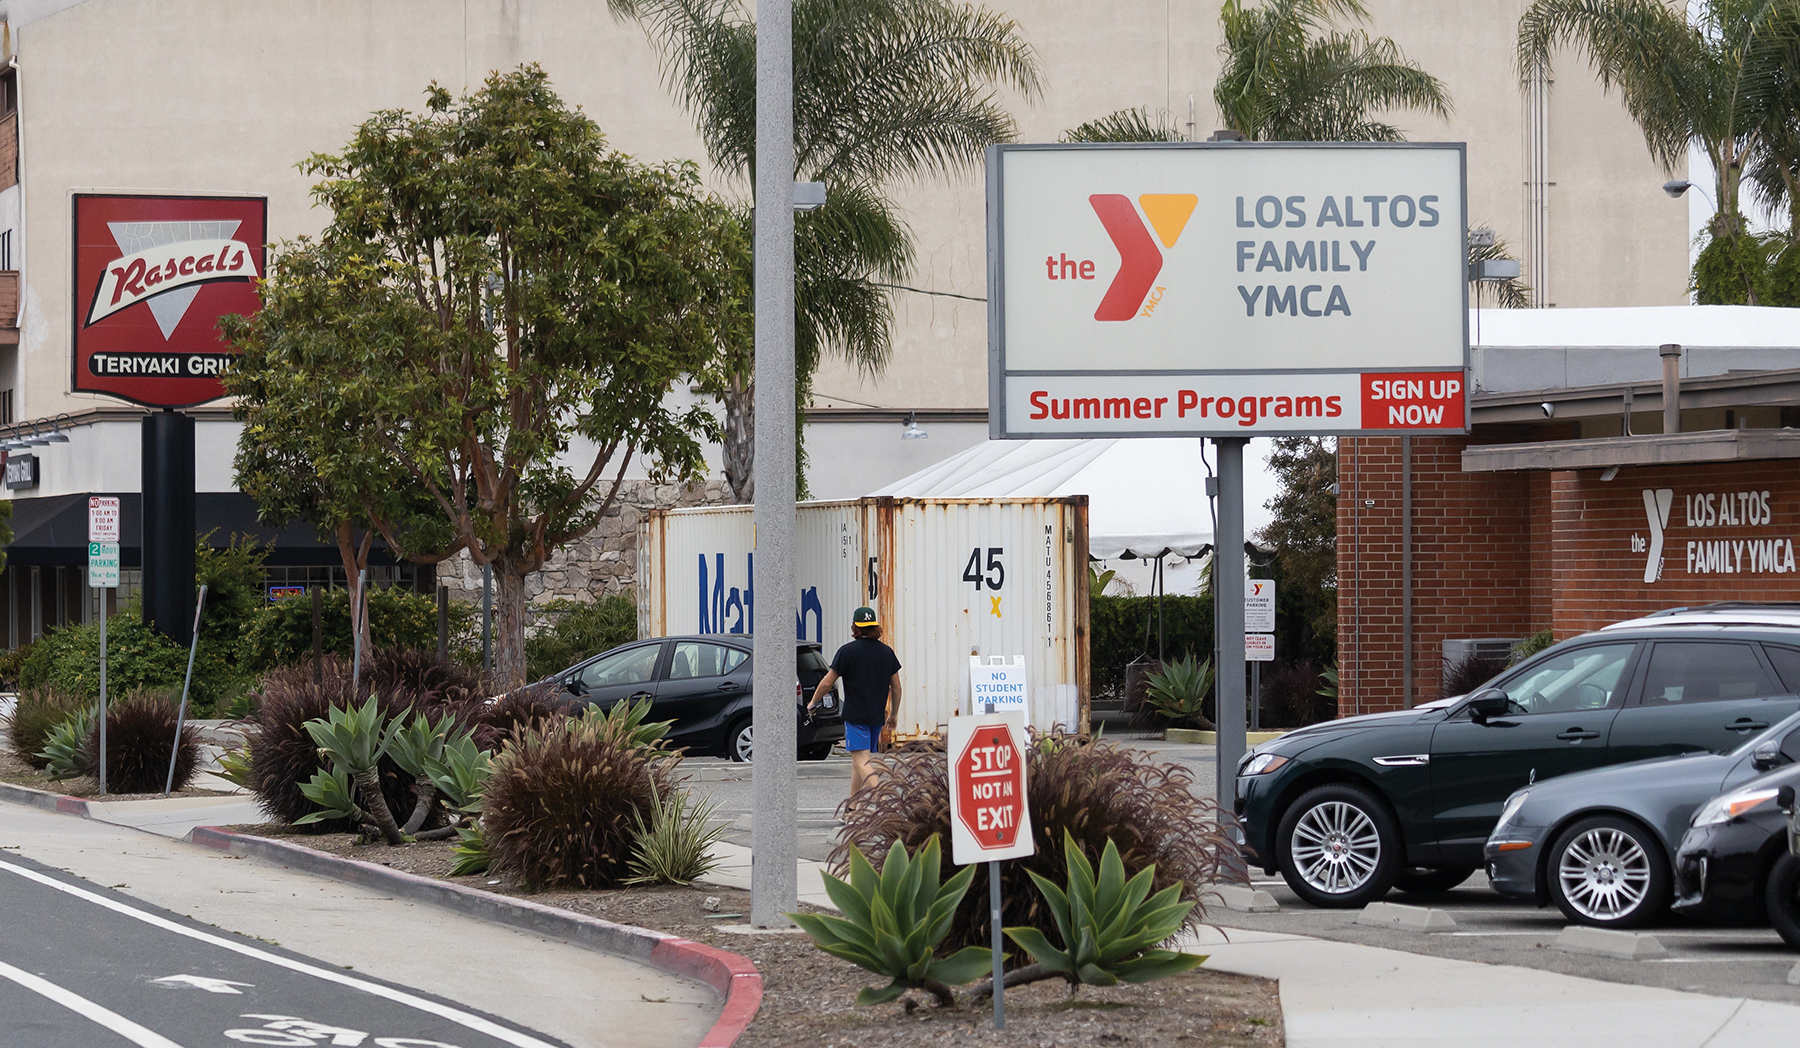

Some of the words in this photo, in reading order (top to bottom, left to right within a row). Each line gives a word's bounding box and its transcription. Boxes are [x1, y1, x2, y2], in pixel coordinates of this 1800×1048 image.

[1236, 195, 1306, 228] LOS
[1316, 195, 1440, 227] ALTOS
[1046, 253, 1096, 280] the
[1236, 240, 1376, 272] FAMILY
[110, 245, 245, 307] Rascals
[1140, 286, 1167, 318] YMCA
[1237, 285, 1352, 317] YMCA
[94, 355, 180, 374] TERIYAKI
[187, 356, 240, 375] GRIL
[1371, 380, 1427, 400] SIGN
[1429, 380, 1460, 399] UP
[1029, 391, 1168, 420] Summer
[1177, 389, 1343, 426] Programs
[1388, 405, 1444, 424] NOW
[99, 499, 118, 507] PARKING
[1687, 493, 1716, 527] LOS
[1718, 490, 1771, 526] ALTOS
[91, 544, 99, 554] 2
[101, 546, 117, 554] HOUR
[1631, 532, 1646, 552] the
[91, 559, 118, 568] PARKING
[963, 547, 1005, 591] 45
[1687, 540, 1744, 574] FAMILY
[1747, 538, 1797, 573] YMCA
[976, 684, 1023, 692] STUDENT
[991, 672, 1007, 681] NO
[978, 695, 1023, 704] PARKING
[970, 745, 1012, 771] STOP
[972, 782, 1001, 800] NOT
[1002, 781, 1013, 797] AN
[977, 805, 1013, 831] EXIT
